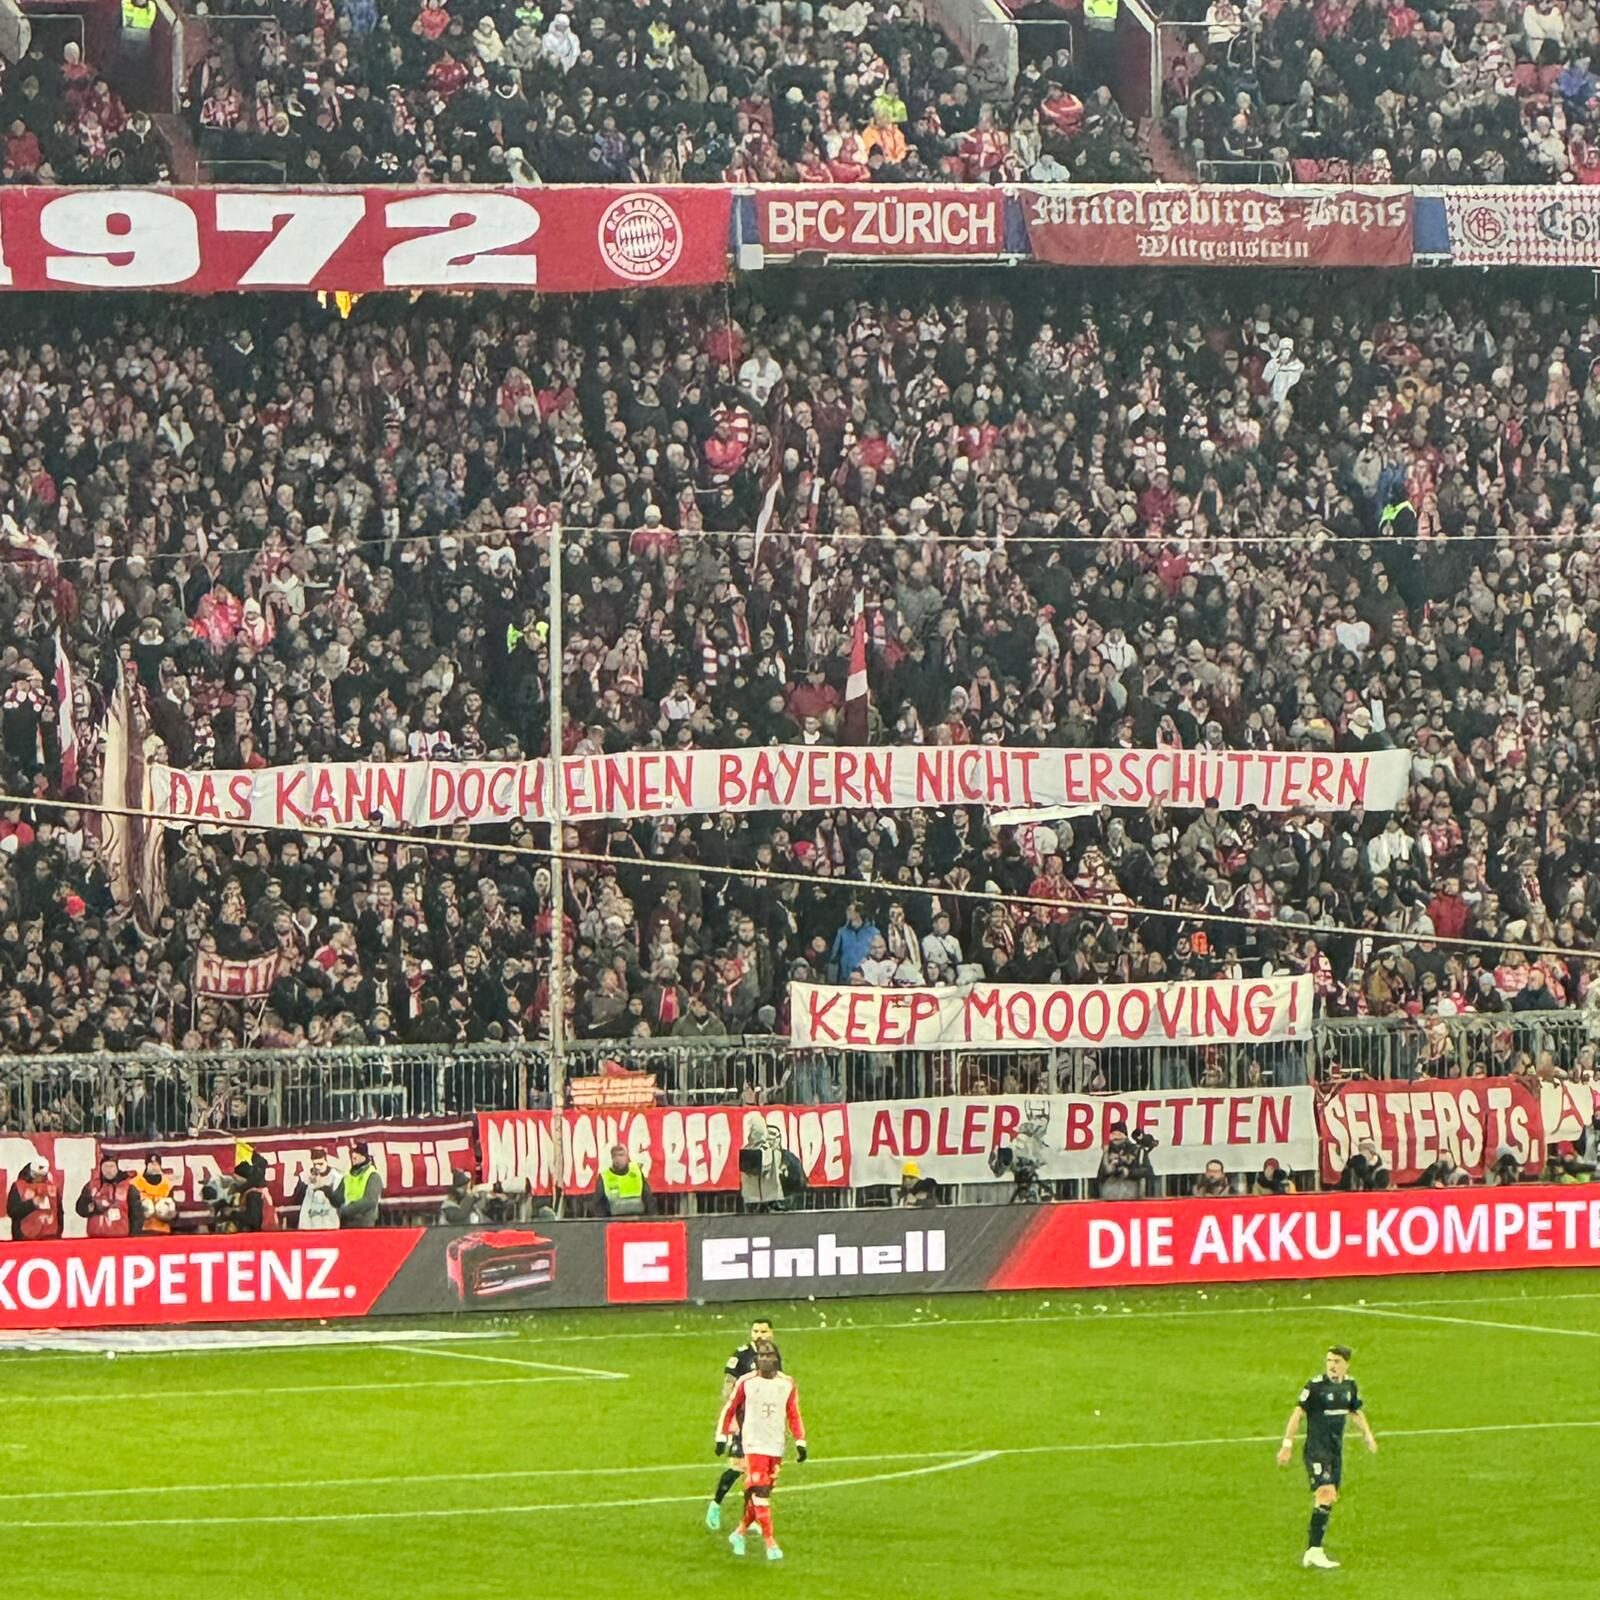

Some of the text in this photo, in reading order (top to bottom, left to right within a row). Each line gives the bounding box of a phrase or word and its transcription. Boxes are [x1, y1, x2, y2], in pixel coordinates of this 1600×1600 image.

[0, 190, 540, 287] 972
[768, 196, 996, 245] BFC ZÜRICH
[170, 749, 1369, 824] DAS KANN DOCH EINEN BAYERN NICHT ERSCHÜTTERN
[809, 981, 1299, 1045] KEEP MOOOOVING!
[662, 1111, 731, 1185] RED
[868, 1105, 1020, 1156] ADLER
[1324, 1088, 1483, 1172] SELTERS
[702, 1230, 946, 1281] Einhell
[1088, 1217, 1174, 1269] DIE
